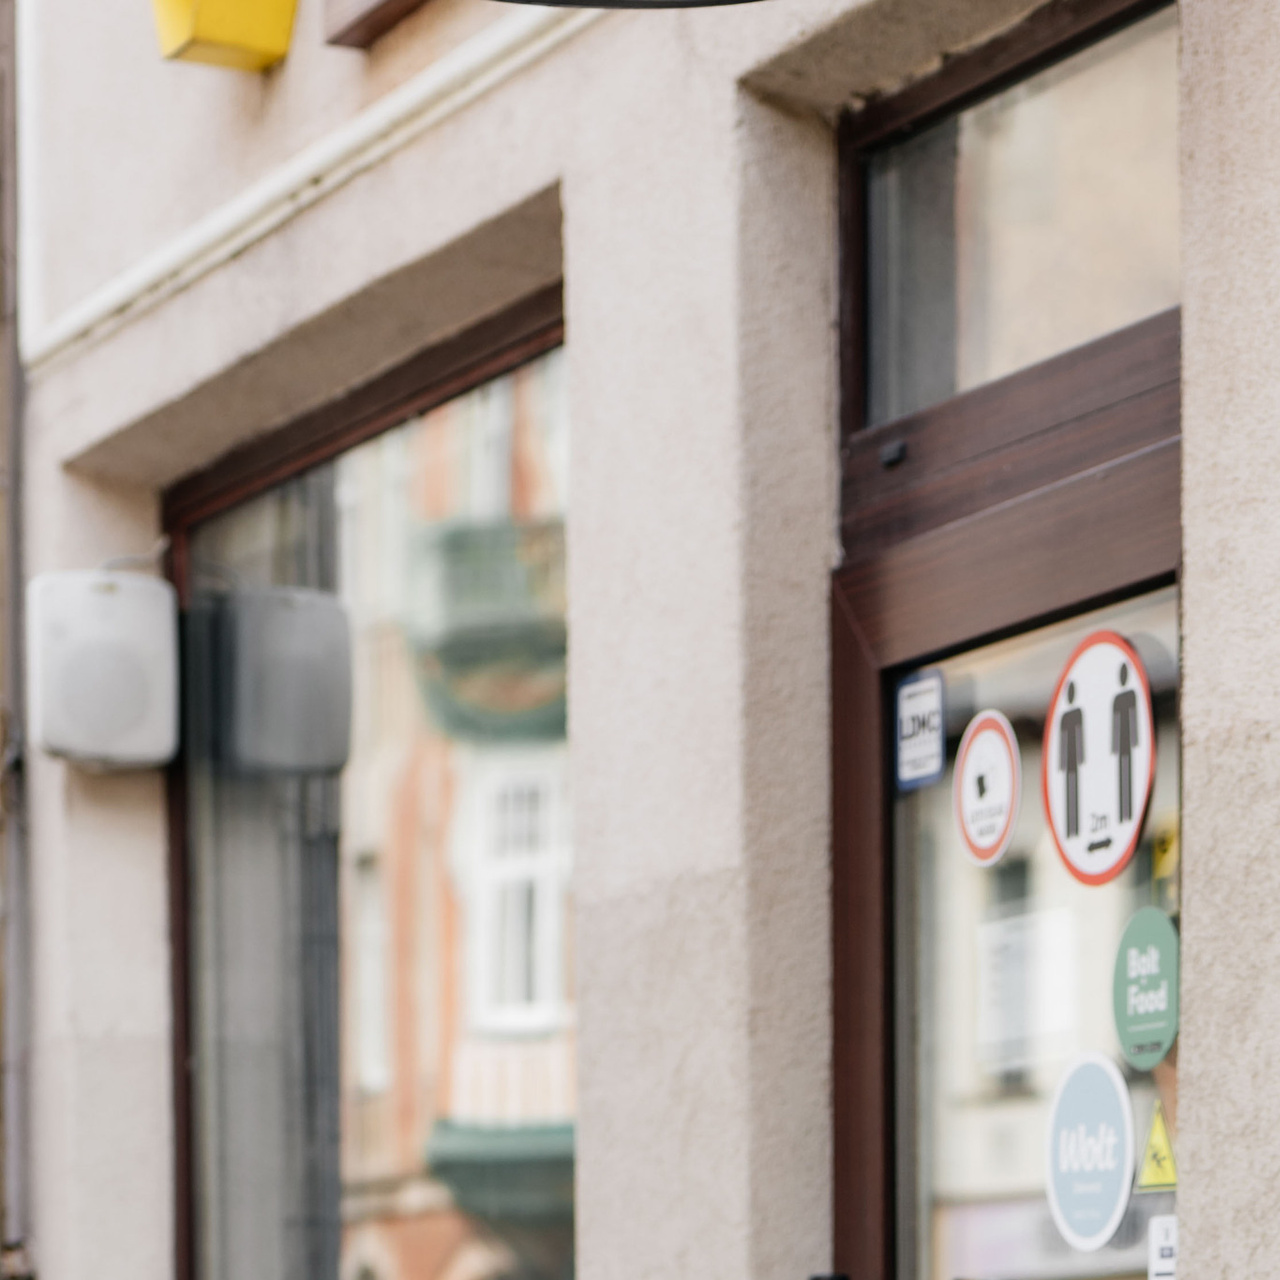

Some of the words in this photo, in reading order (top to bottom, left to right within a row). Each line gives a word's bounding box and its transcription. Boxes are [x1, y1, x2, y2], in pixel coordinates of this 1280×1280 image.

[1126, 944, 1160, 981] Bolt
[1126, 979, 1168, 1016] Food
[1058, 1122, 1118, 1174] Wolt
